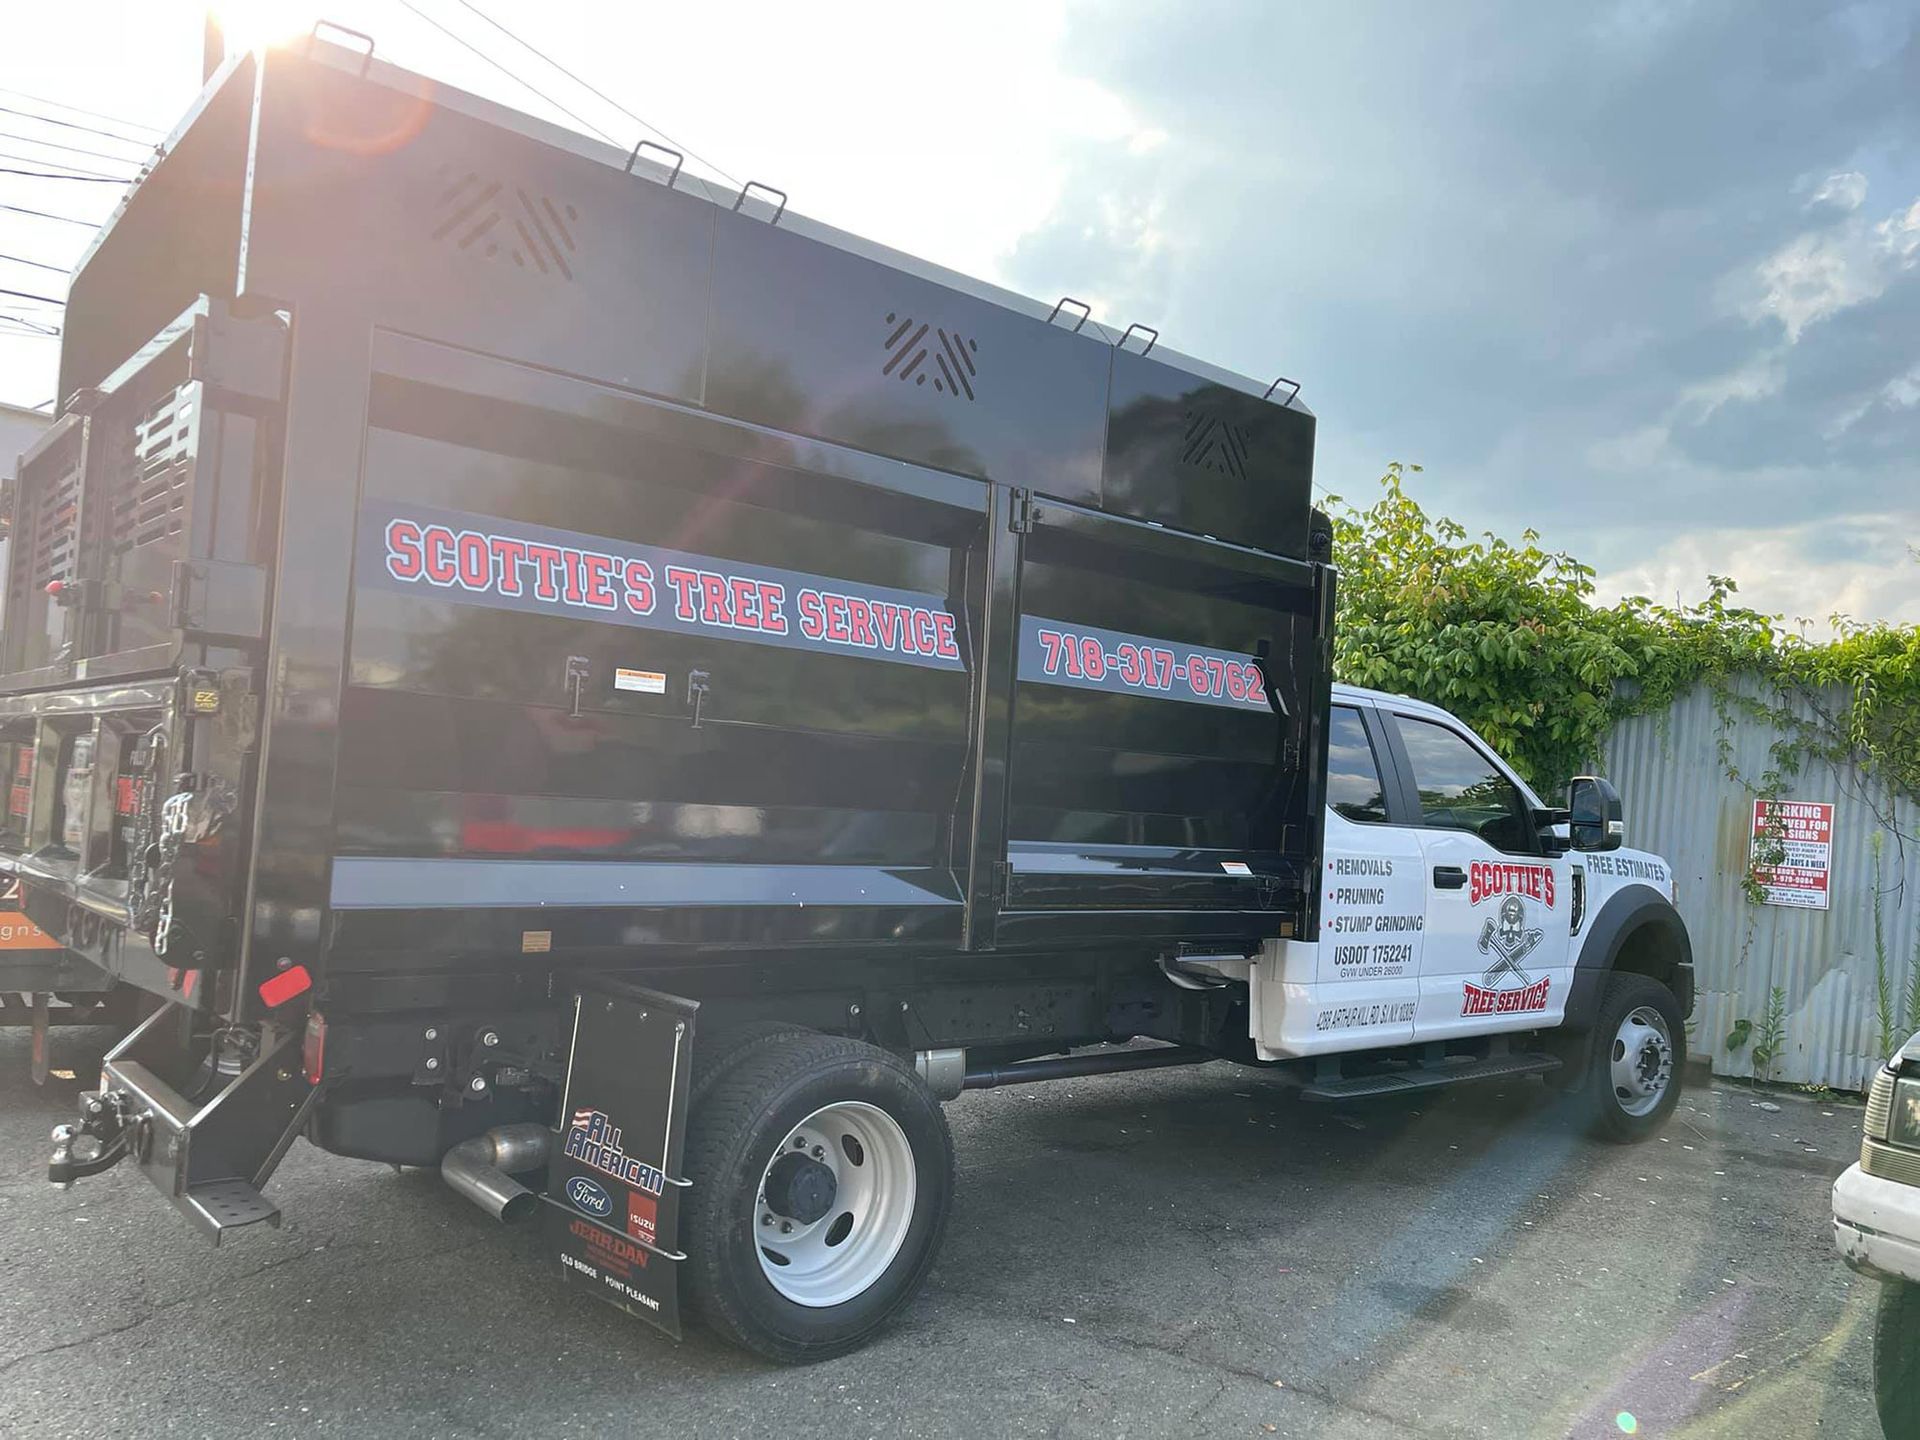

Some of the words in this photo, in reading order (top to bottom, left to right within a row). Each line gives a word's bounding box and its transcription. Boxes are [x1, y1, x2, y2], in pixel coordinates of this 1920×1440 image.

[385, 519, 655, 615] SCOTTIE'S
[666, 564, 788, 635] TREE
[799, 591, 959, 659] SERVICE
[1038, 630, 1267, 703] 718-317-6762
[1788, 829, 1819, 841] SIGNS
[1809, 820, 1828, 831] FOR
[1336, 859, 1393, 876] REMOVALS
[1586, 854, 1613, 875] FREE
[1615, 858, 1665, 882] ESTIMATES
[1791, 858, 1804, 867] DAYS
[1805, 859, 1810, 867] A
[1811, 860, 1826, 868] WEEK
[1797, 870, 1824, 878] TOWING
[1470, 860, 1556, 910] SCOTTIE'S
[1336, 888, 1384, 905] PRUNING
[1335, 916, 1373, 933] STUMP
[1375, 915, 1423, 932] GRINDING
[1334, 945, 1370, 965] USDOT
[1372, 944, 1412, 963] 1752241
[1340, 967, 1357, 978] GVW
[1359, 966, 1382, 977] UNDER
[1461, 981, 1496, 1016] TREE
[1495, 975, 1550, 1015] SERVICE
[587, 1110, 623, 1153] ALL
[565, 1126, 665, 1196] AMERICAN
[573, 1181, 605, 1211] Ford
[630, 1213, 655, 1230] ISUZU
[561, 1253, 573, 1266] OLD
[574, 1260, 597, 1279] BRIDGE
[605, 1275, 624, 1292] POINT
[626, 1286, 660, 1311] PLEASANT
